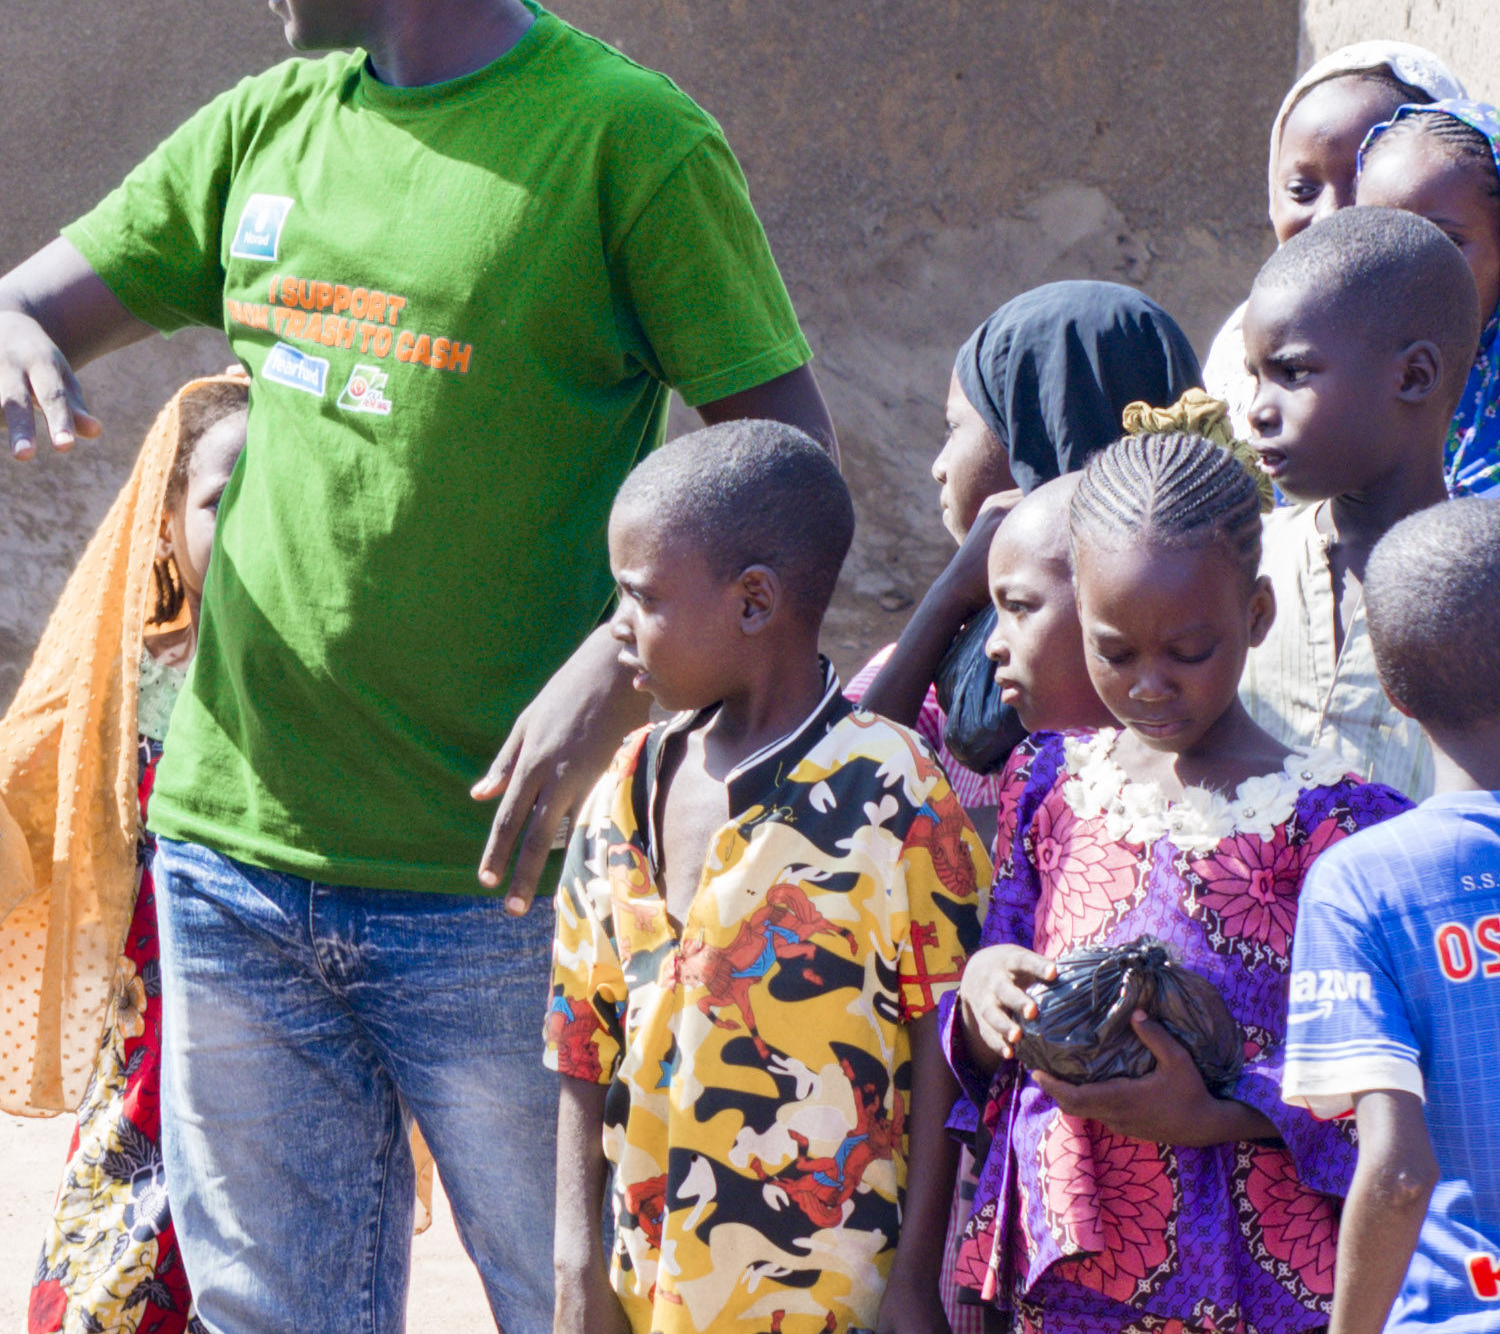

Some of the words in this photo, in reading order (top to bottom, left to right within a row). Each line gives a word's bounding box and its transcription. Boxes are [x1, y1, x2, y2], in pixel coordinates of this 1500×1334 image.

[269, 275, 281, 304] I
[281, 276, 407, 326] SUPPORT
[273, 306, 356, 349] TRASH
[360, 323, 392, 358] TO
[396, 330, 472, 373] CASH
